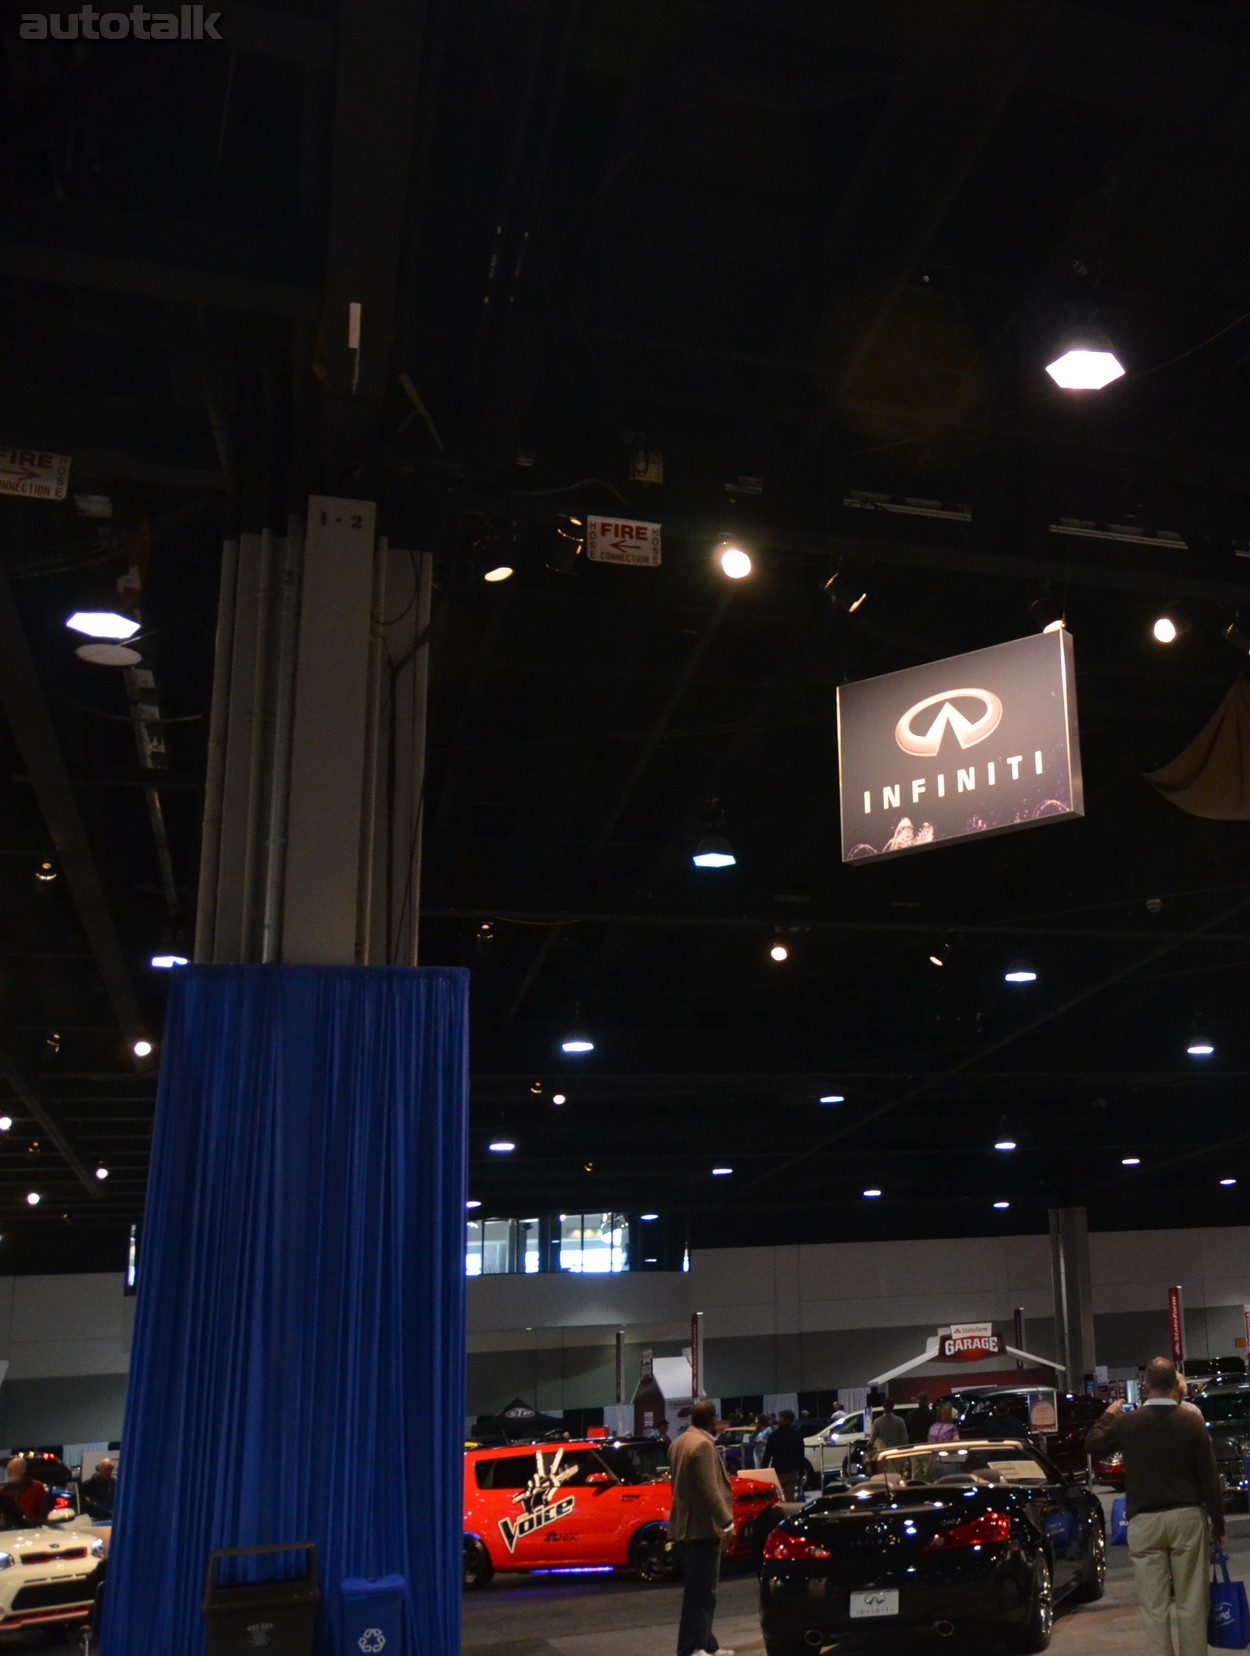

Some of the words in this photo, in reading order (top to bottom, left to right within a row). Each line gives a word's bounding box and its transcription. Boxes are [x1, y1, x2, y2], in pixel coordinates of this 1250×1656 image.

[600, 522, 648, 541] FIRE
[600, 551, 650, 564] CONNECTION
[863, 750, 1043, 814] INFINITI
[944, 1336, 999, 1356] GARAGE
[498, 1494, 576, 1554] Voice
